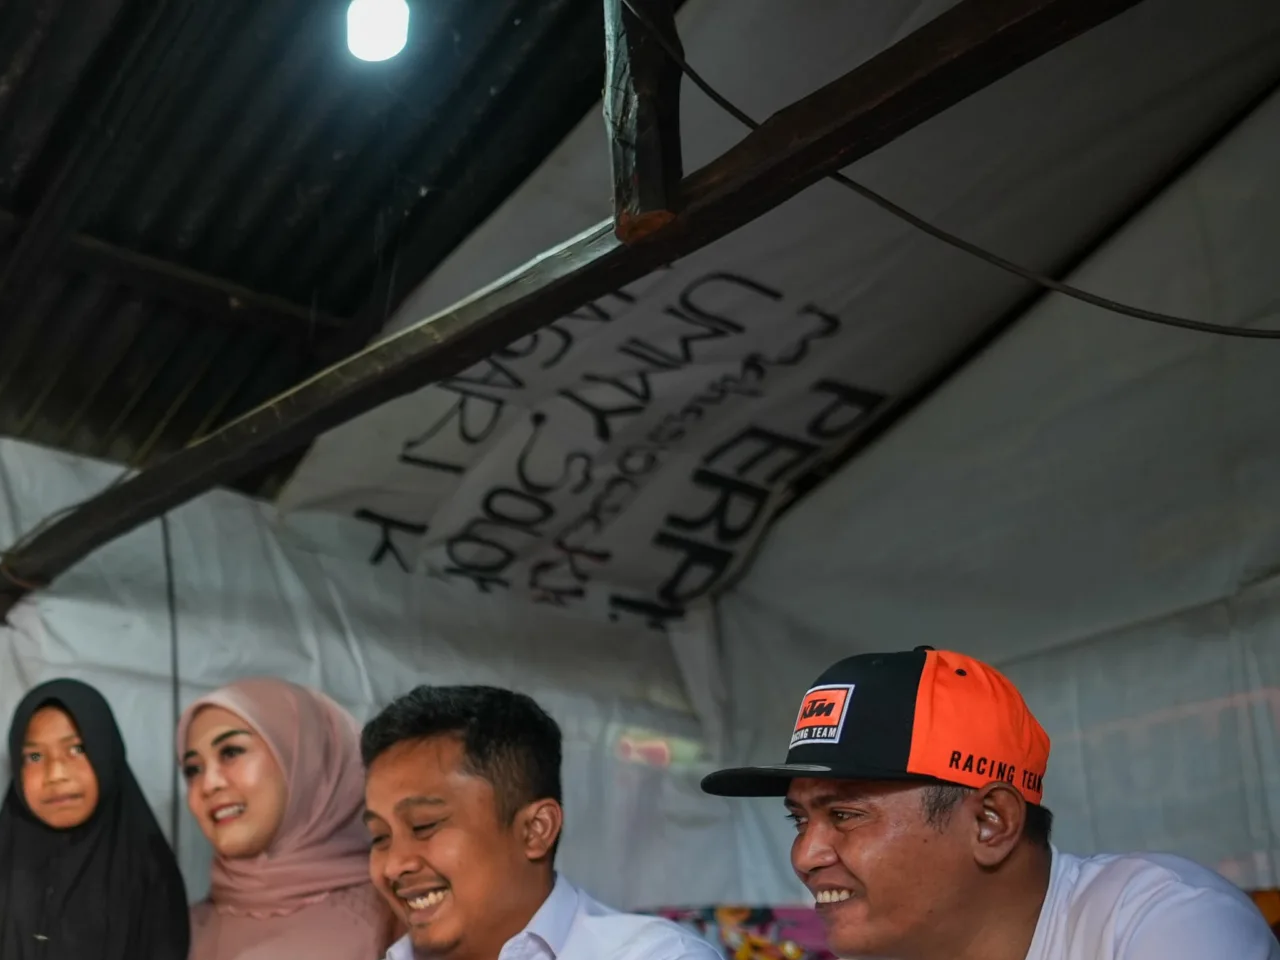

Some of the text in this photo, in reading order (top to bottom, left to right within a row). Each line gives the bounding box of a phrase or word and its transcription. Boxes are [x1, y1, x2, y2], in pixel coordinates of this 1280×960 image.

[556, 272, 784, 444] UMMY
[800, 698, 836, 721] KTM
[812, 727, 837, 738] TEAM
[948, 750, 1016, 783] RACING
